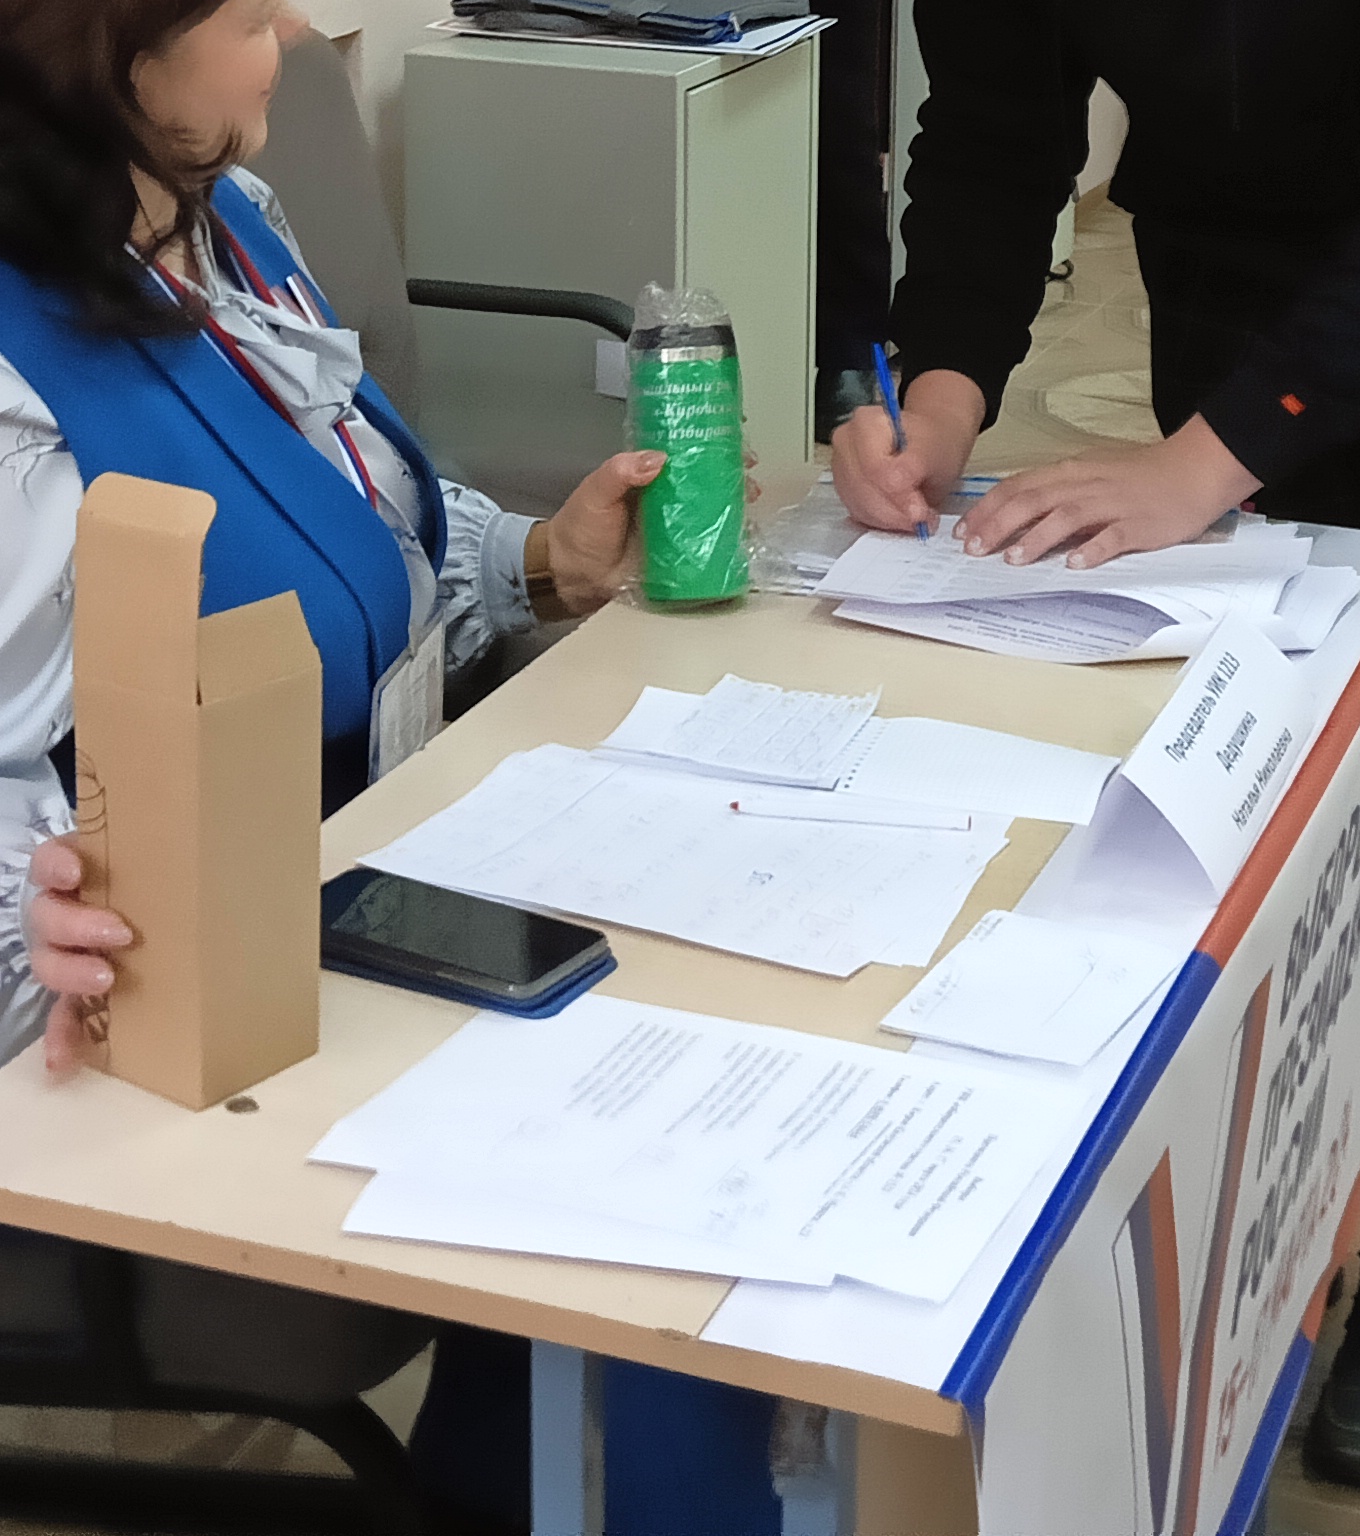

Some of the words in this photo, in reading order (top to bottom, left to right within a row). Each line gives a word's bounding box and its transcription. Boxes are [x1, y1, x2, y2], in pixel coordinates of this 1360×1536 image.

[1163, 694, 1218, 763] Председатель
[1203, 670, 1229, 700] УИК
[1217, 650, 1241, 681] 1213
[1214, 710, 1258, 775] Дедушкина
[1231, 781, 1262, 832] Наталья
[1254, 726, 1294, 791] Николаевна
[1230, 1056, 1331, 1340] РОССИИ
